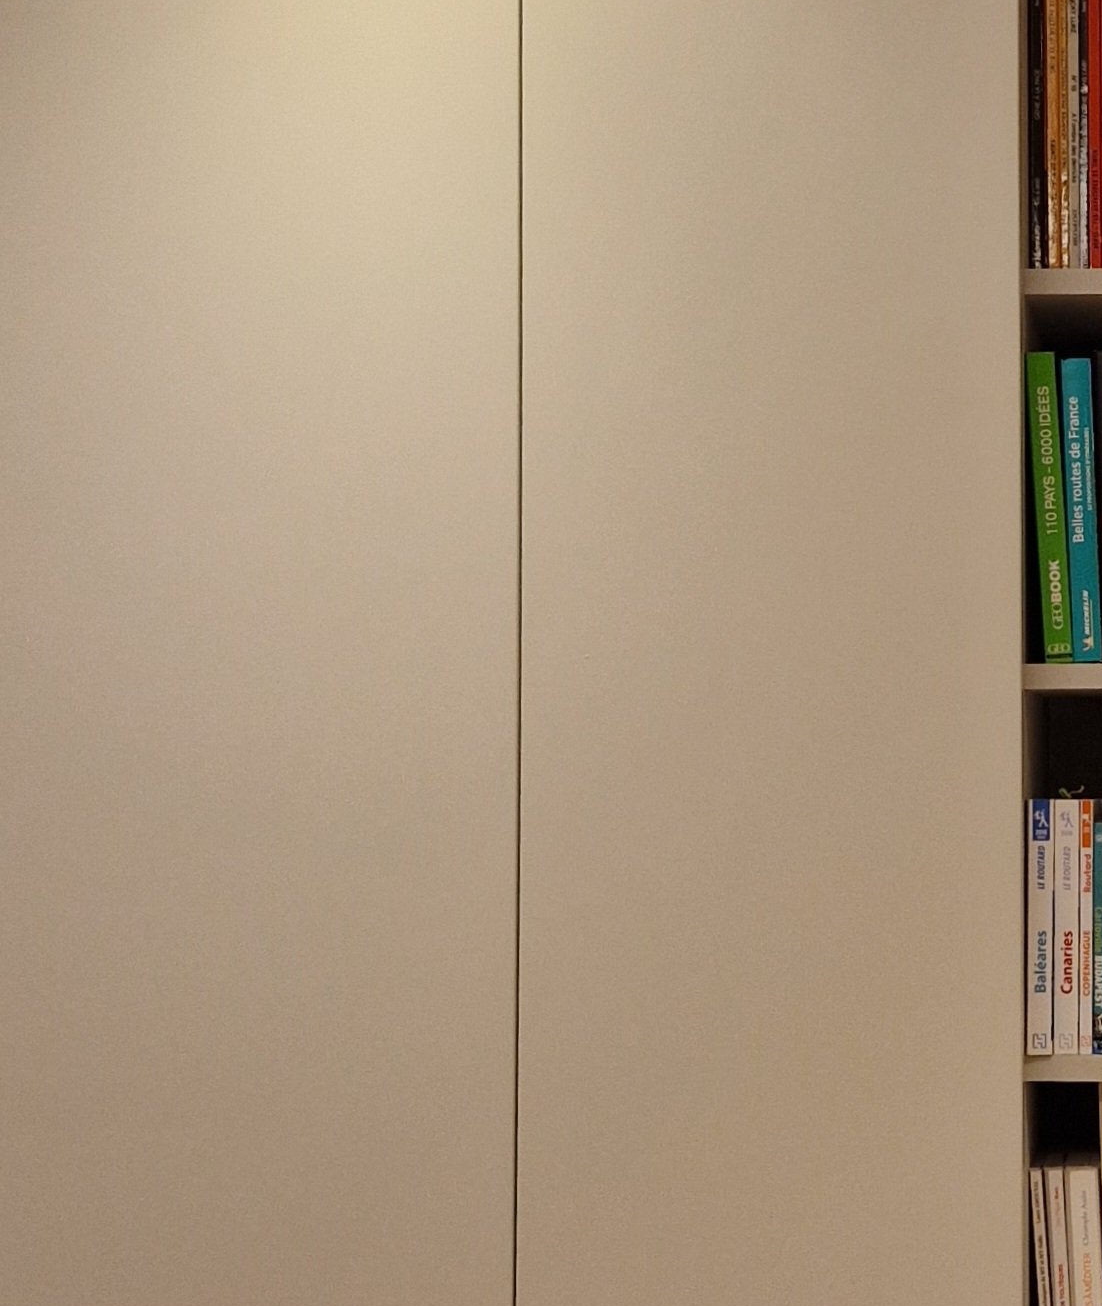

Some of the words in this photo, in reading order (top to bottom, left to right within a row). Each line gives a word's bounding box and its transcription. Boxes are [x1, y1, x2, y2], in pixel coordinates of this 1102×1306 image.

[1035, 385, 1051, 426] IDÉES
[1067, 396, 1080, 439] France
[1039, 429, 1054, 465] 6000
[1069, 442, 1081, 459] de
[1043, 476, 1057, 509] PAYS
[1070, 462, 1083, 501] routes
[1045, 512, 1059, 535] 110
[1071, 505, 1085, 543] Belles
[1048, 559, 1065, 630] GEOBOOK
[1081, 589, 1090, 635] MICHELIN
[1036, 845, 1045, 881] ROUTARD
[1062, 846, 1071, 881] ROUTARD
[1083, 854, 1091, 893] Routard
[1036, 882, 1045, 890] LE
[1033, 930, 1047, 994] Baléares
[1060, 930, 1073, 994] Canaries
[1082, 930, 1090, 997] COPENHAGUE
